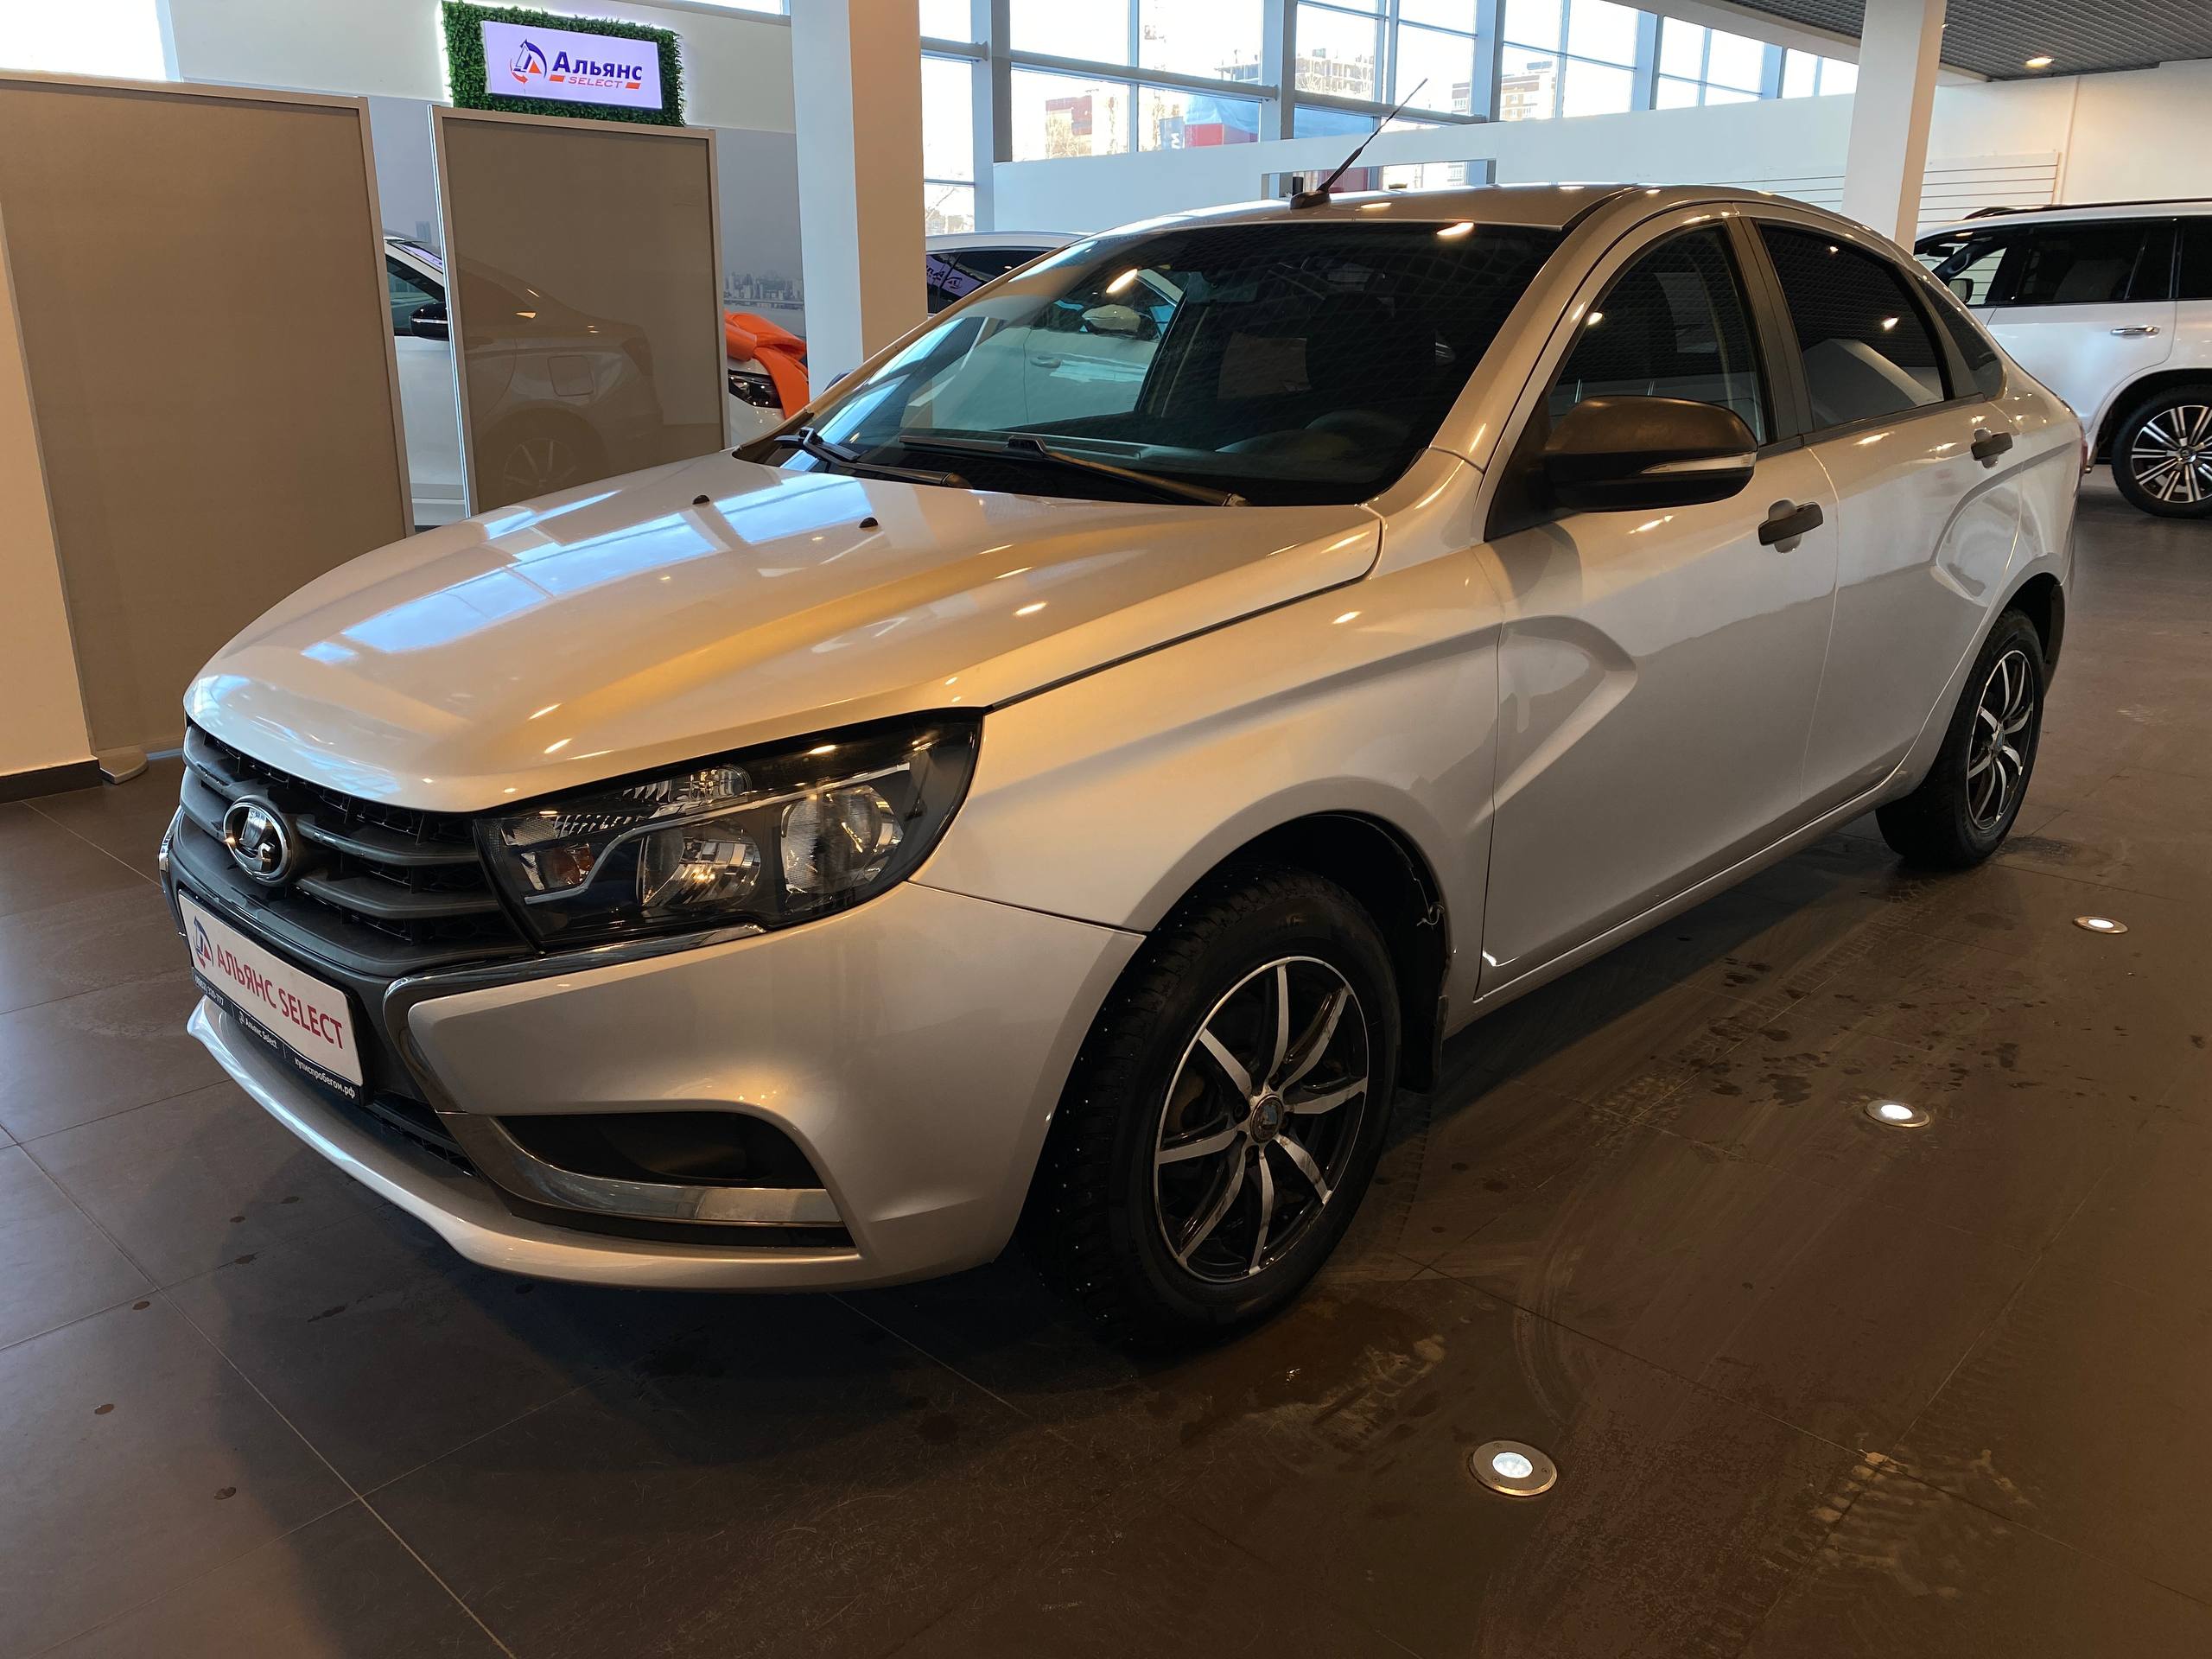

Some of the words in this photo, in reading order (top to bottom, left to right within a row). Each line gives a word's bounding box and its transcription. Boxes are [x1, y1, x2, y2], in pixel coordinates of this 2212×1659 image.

[552, 51, 642, 80] Альянс
[568, 76, 623, 89] SELECT
[216, 944, 276, 1009] АЛЬЯНС
[278, 988, 343, 1050] SELECT
